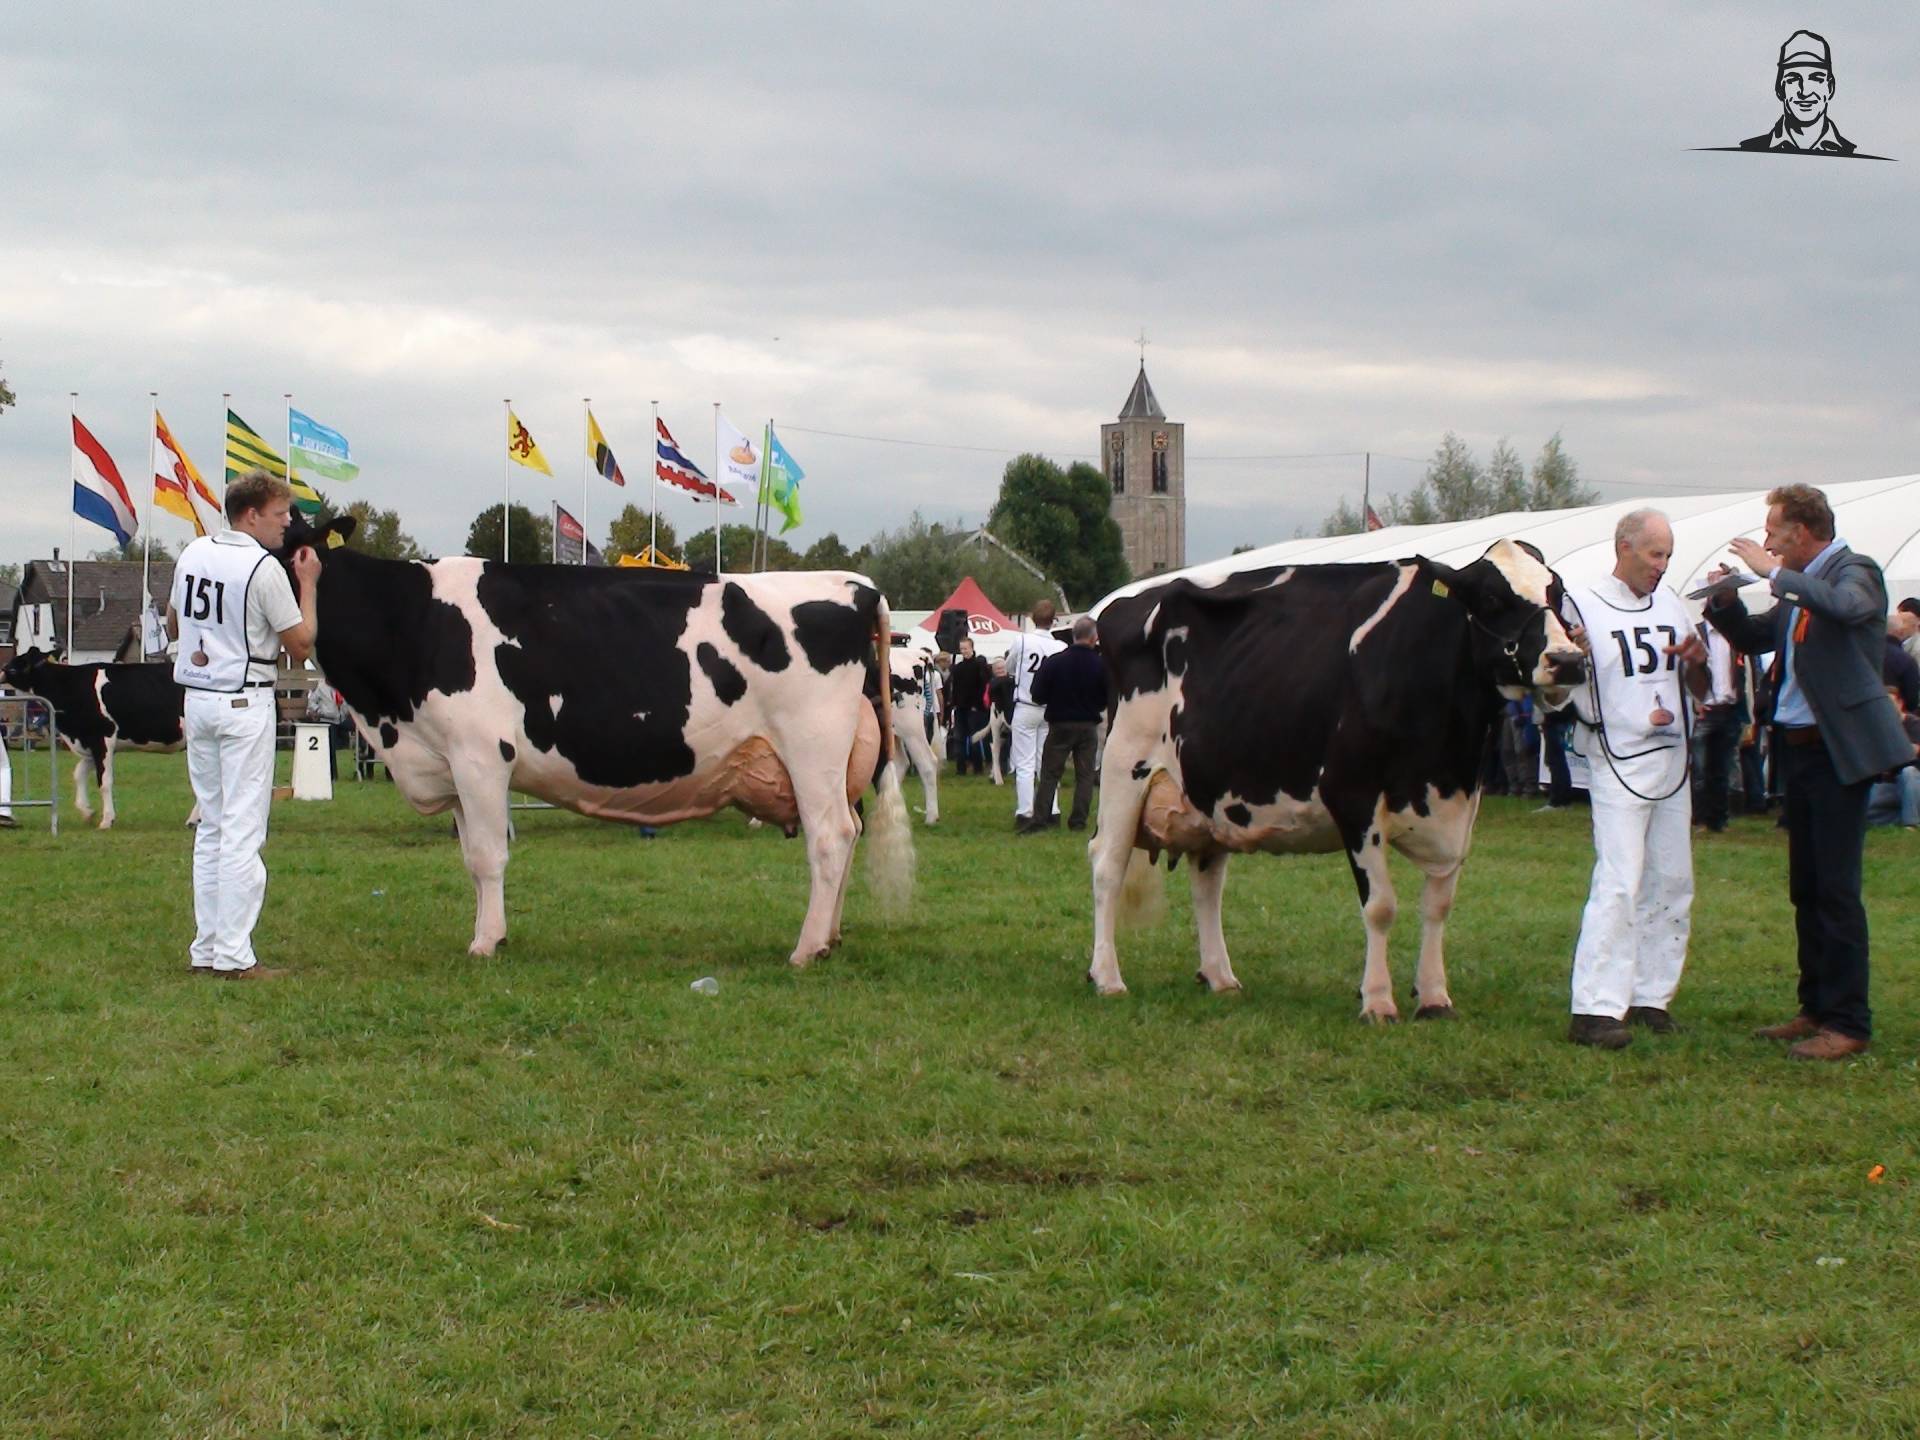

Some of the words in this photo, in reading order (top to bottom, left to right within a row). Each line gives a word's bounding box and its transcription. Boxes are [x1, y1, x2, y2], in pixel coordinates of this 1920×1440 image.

[184, 574, 224, 625] 151
[1027, 653, 1048, 673] 2
[1610, 624, 1676, 677] 157
[308, 736, 319, 751] 2
